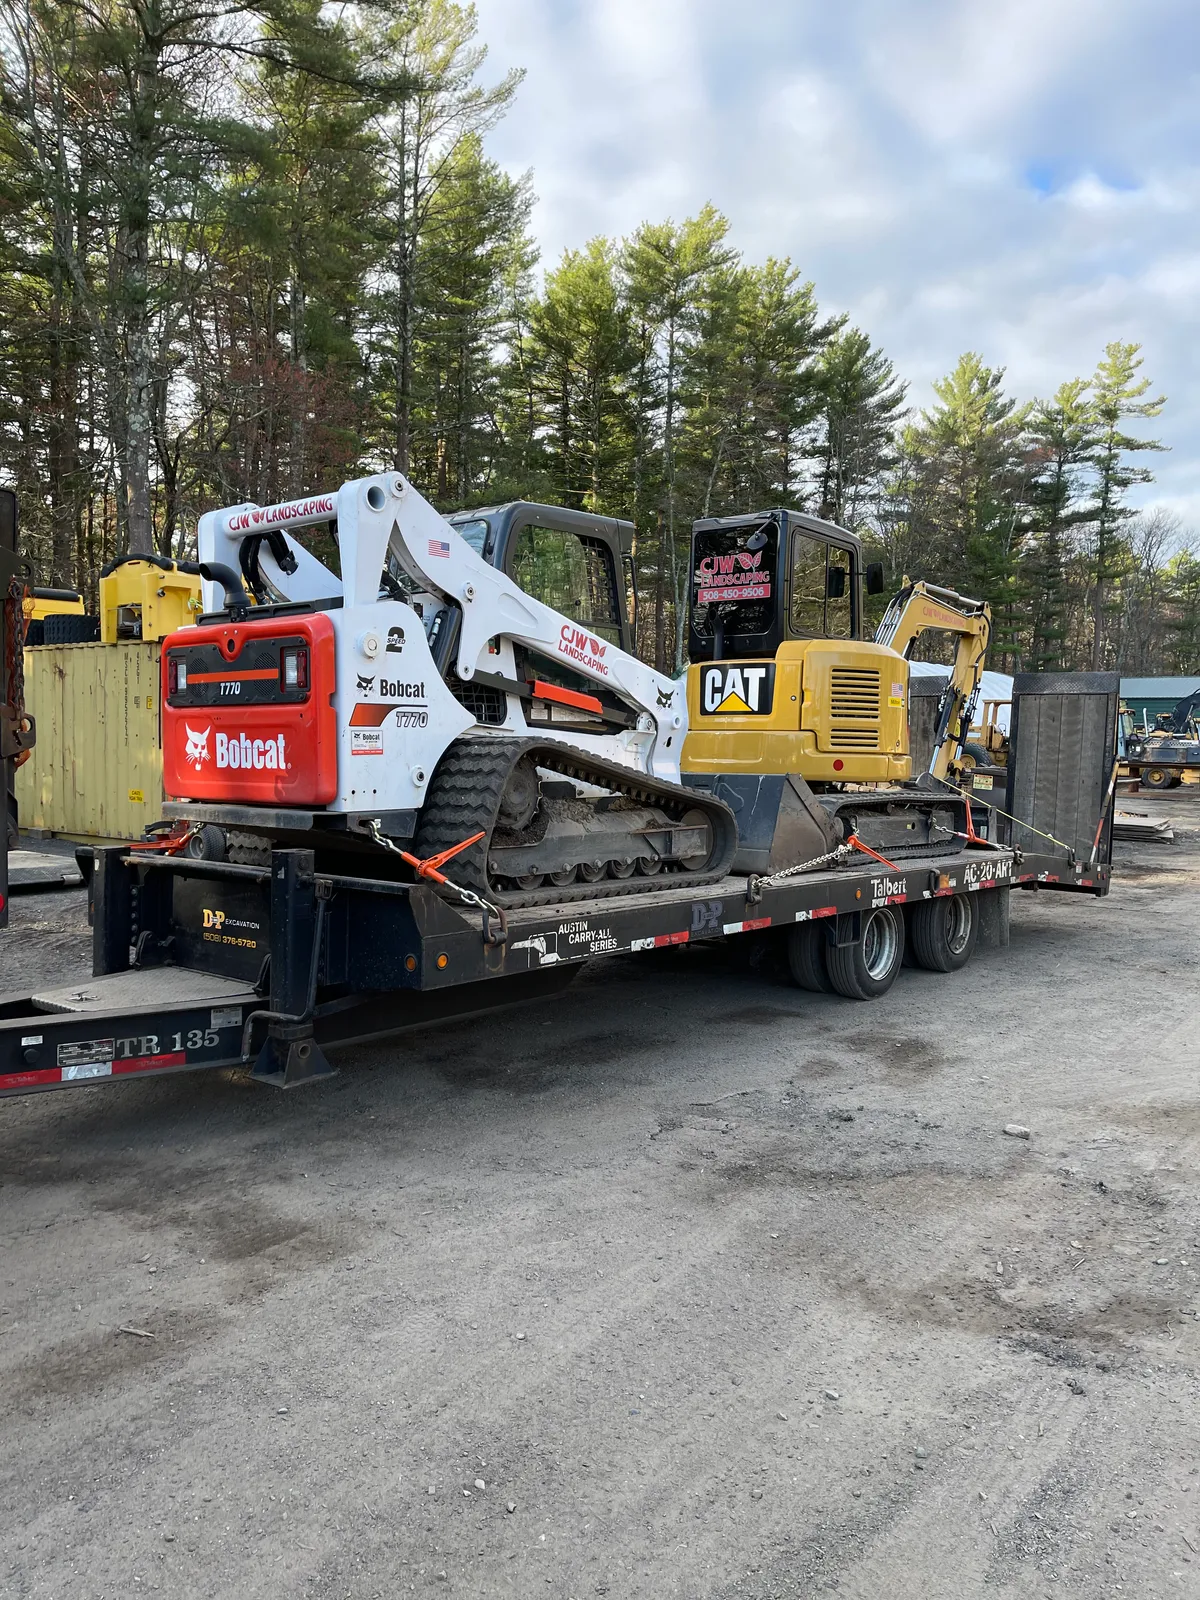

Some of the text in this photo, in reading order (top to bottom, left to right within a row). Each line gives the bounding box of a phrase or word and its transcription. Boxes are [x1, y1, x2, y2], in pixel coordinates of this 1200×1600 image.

[229, 498, 333, 531] CJW LANDSCAPING
[700, 555, 735, 575] CJW
[700, 570, 770, 588] LANDSCAPING
[702, 587, 765, 601] 508-450-9506
[386, 626, 405, 653] 2
[387, 637, 406, 645] SPEED
[560, 624, 588, 652] CJW
[558, 639, 609, 676] LANDSCAPING
[220, 682, 241, 696] T770
[380, 679, 425, 698] Bobcat
[704, 667, 766, 712] CAT
[396, 711, 428, 728] T770
[362, 733, 380, 741] Bobcat
[215, 732, 287, 770] Bobcat
[870, 877, 907, 898] Talbert
[225, 918, 260, 930] EXCAVATION
[558, 920, 589, 935] AUSTIN
[568, 928, 612, 945] CARRY-ALL
[589, 938, 618, 952] SERIES
[117, 1035, 160, 1058] TR
[171, 1028, 220, 1051] 135
